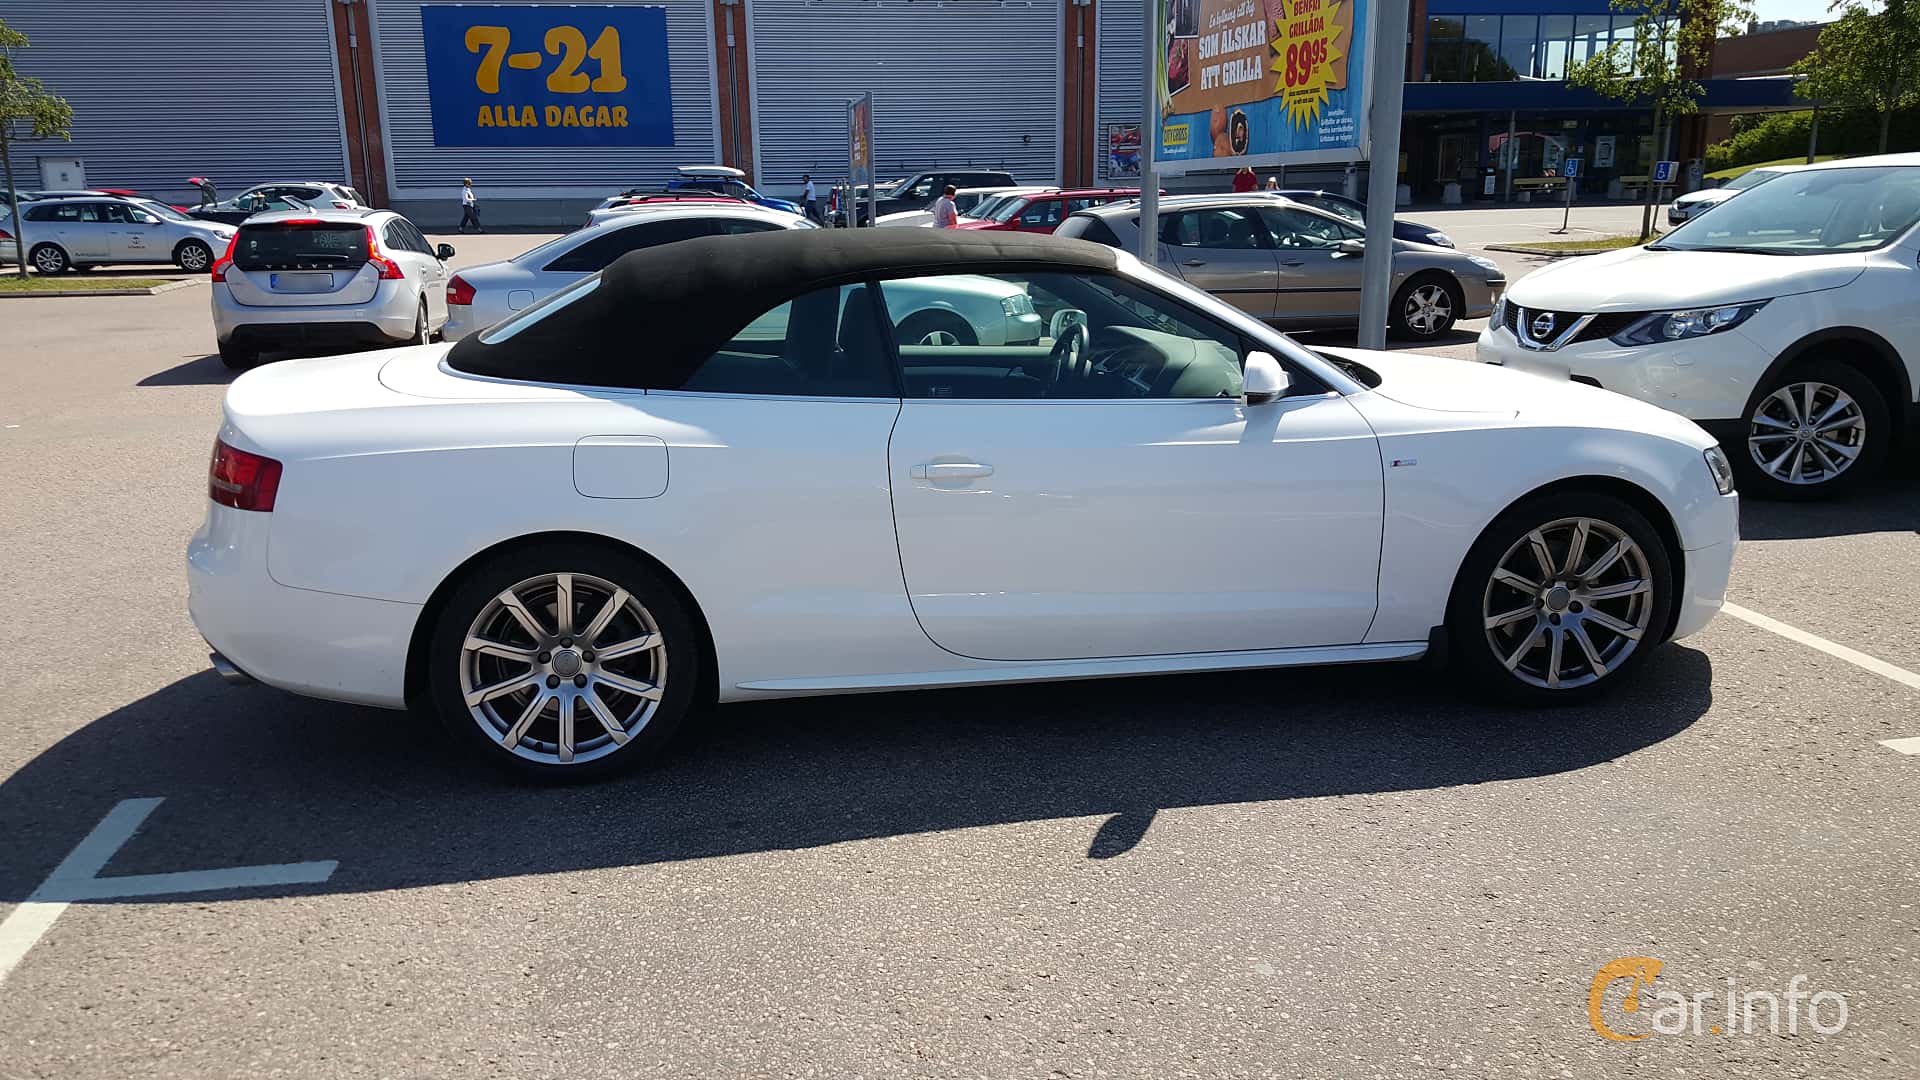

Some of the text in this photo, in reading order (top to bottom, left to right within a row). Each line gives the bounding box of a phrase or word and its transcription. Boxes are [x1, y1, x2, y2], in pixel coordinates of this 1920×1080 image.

[1199, 20, 1266, 60] SOM ÄLSKAR
[1289, 14, 1325, 39] GRILLÅDA
[465, 25, 628, 94] 7-21
[1200, 55, 1263, 90] ATT GRILLA
[477, 105, 629, 128] ALLA DAGAR
